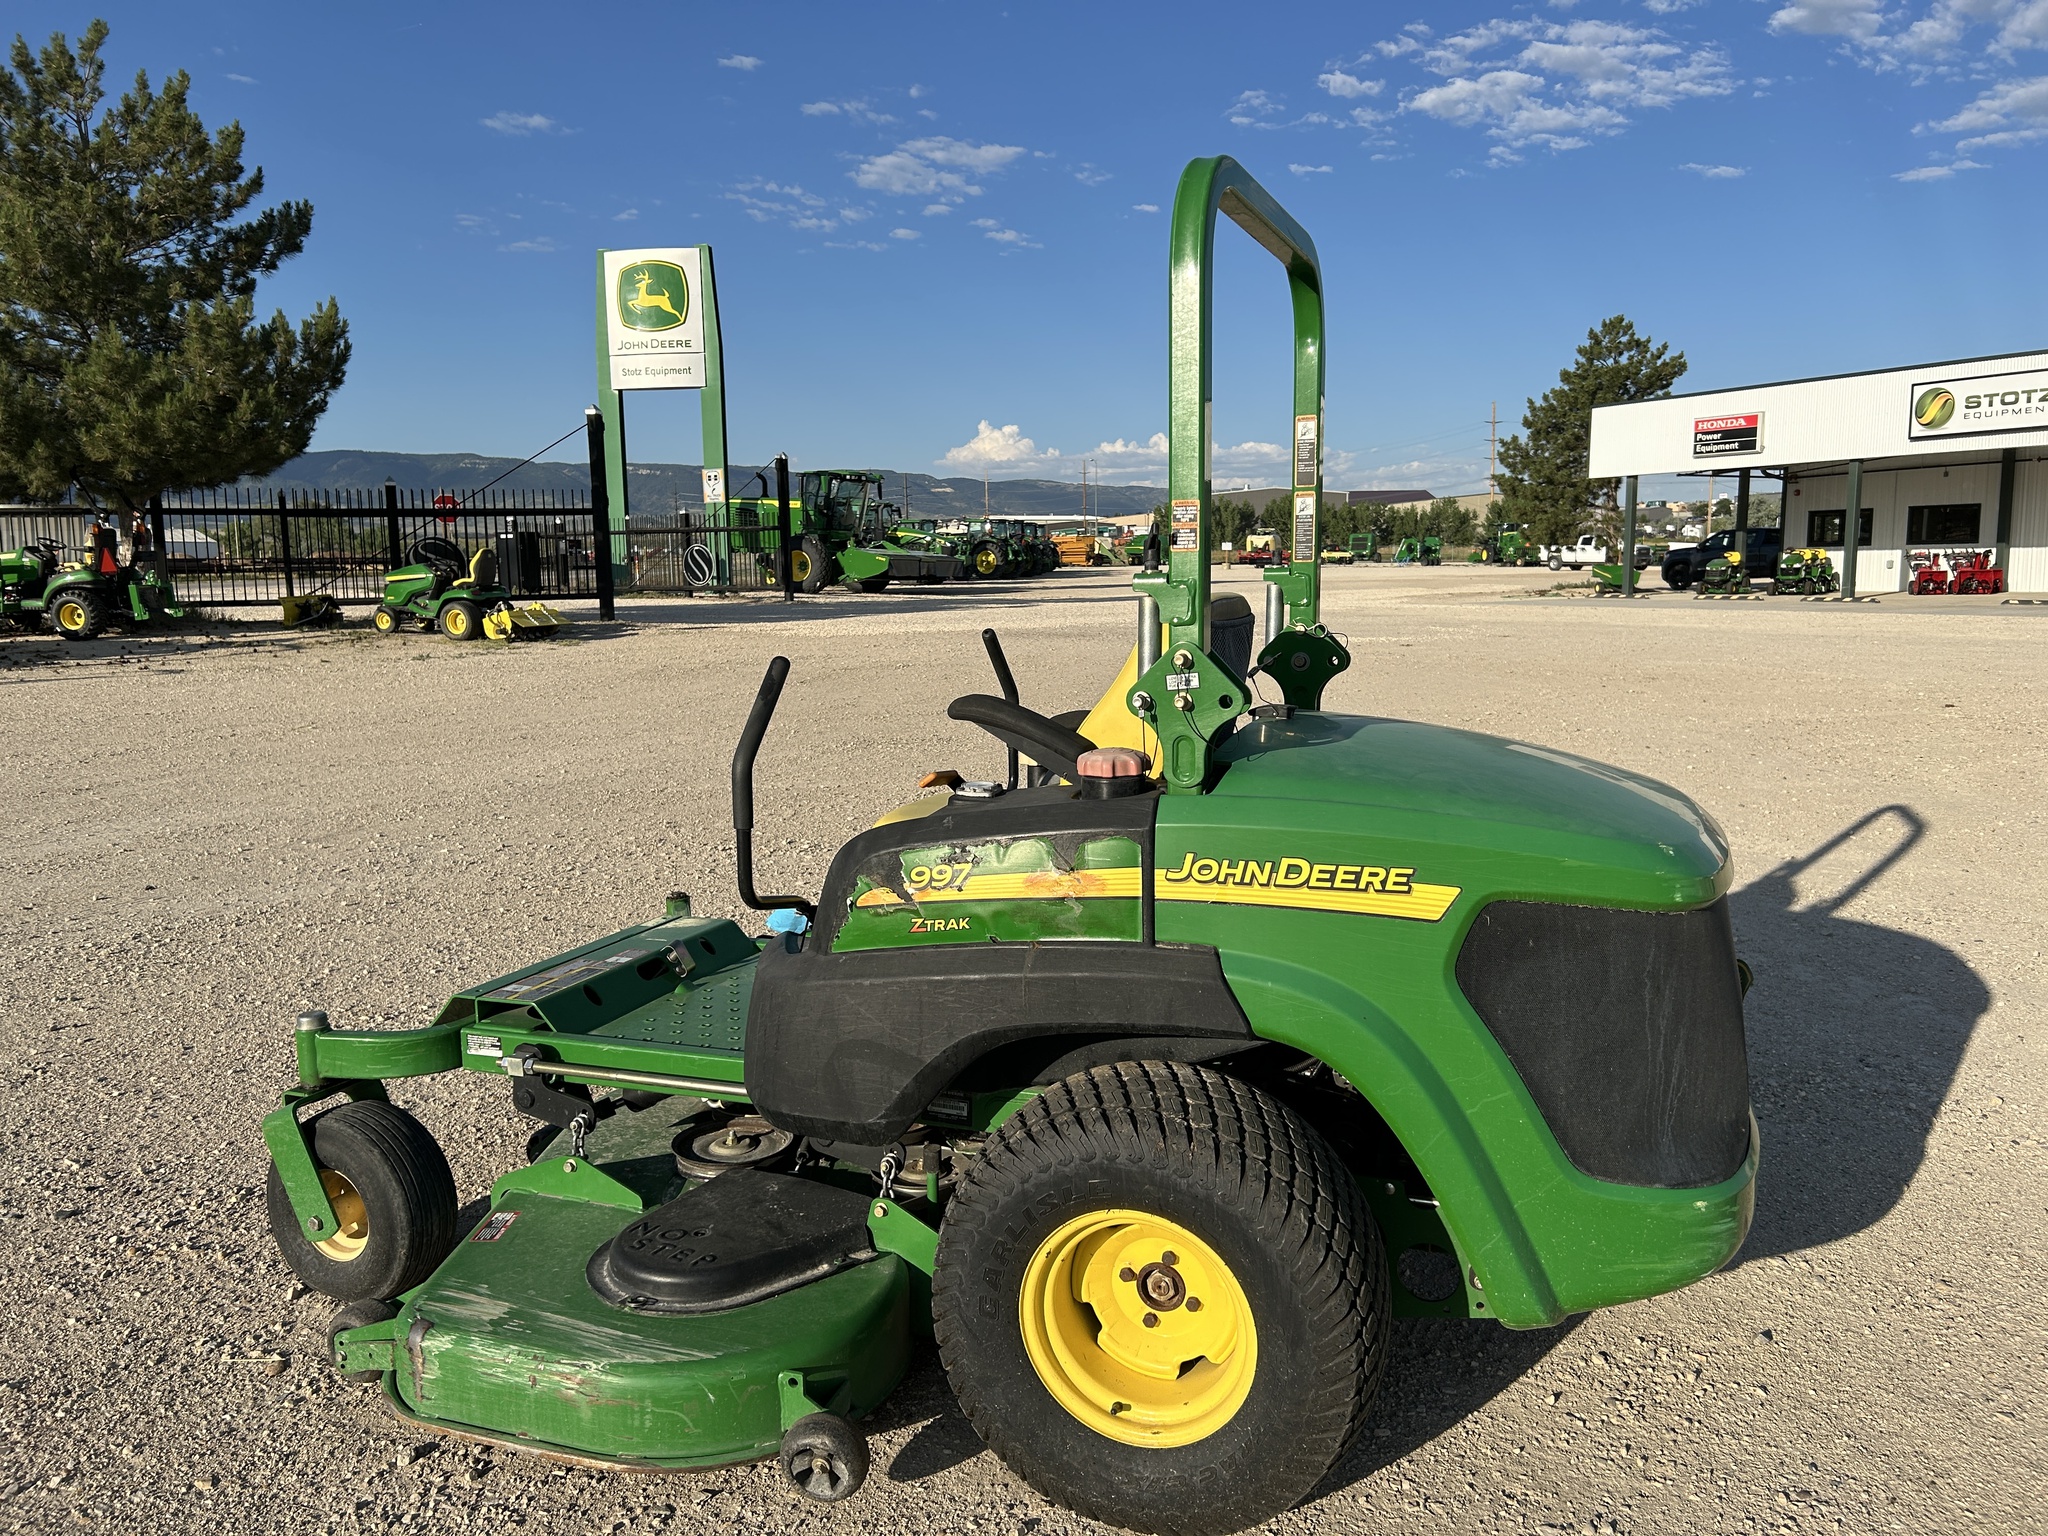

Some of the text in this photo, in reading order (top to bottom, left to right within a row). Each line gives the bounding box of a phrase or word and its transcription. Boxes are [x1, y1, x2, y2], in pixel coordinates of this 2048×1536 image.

[618, 339, 692, 350] JOHN DEERE
[621, 366, 692, 378] Stotz Equipment
[1697, 418, 1747, 430] HONDA
[1696, 433, 1722, 441] Power
[1696, 442, 1739, 453] Equipment
[908, 863, 973, 890] 997
[1165, 852, 1417, 895] JOHN DEERE
[627, 1221, 689, 1241] NO
[628, 1239, 719, 1267] STEP
[978, 1178, 1113, 1322] CARLISLE
